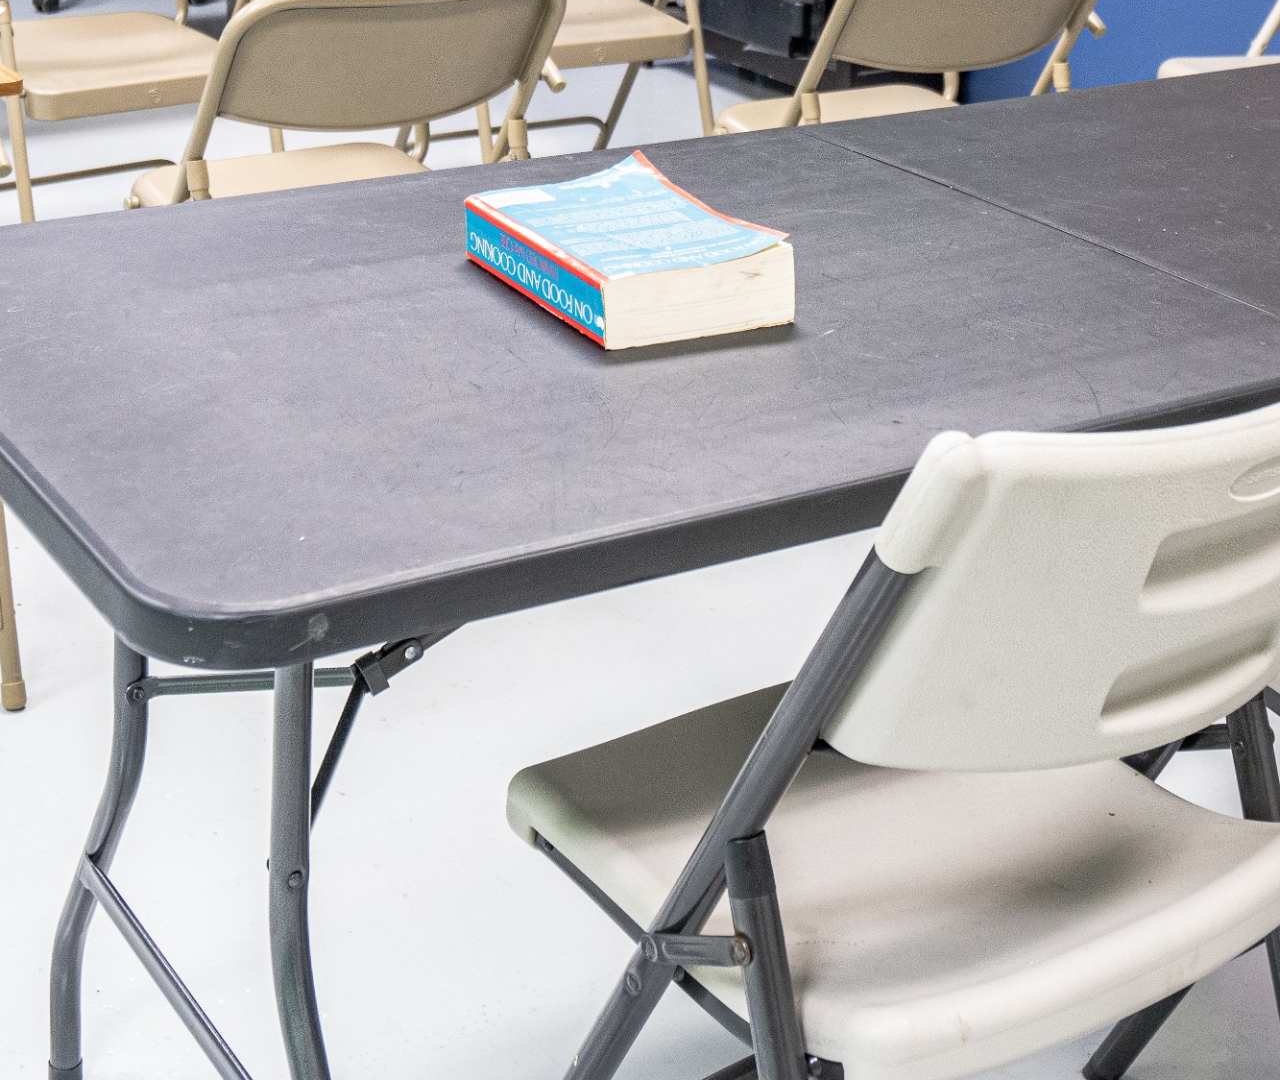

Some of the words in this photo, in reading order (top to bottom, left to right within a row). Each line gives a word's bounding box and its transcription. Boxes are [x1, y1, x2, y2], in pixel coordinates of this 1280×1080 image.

[469, 231, 516, 276] COOKING
[517, 262, 542, 292] AND
[541, 278, 574, 313] FOOD
[574, 297, 593, 325] ON
